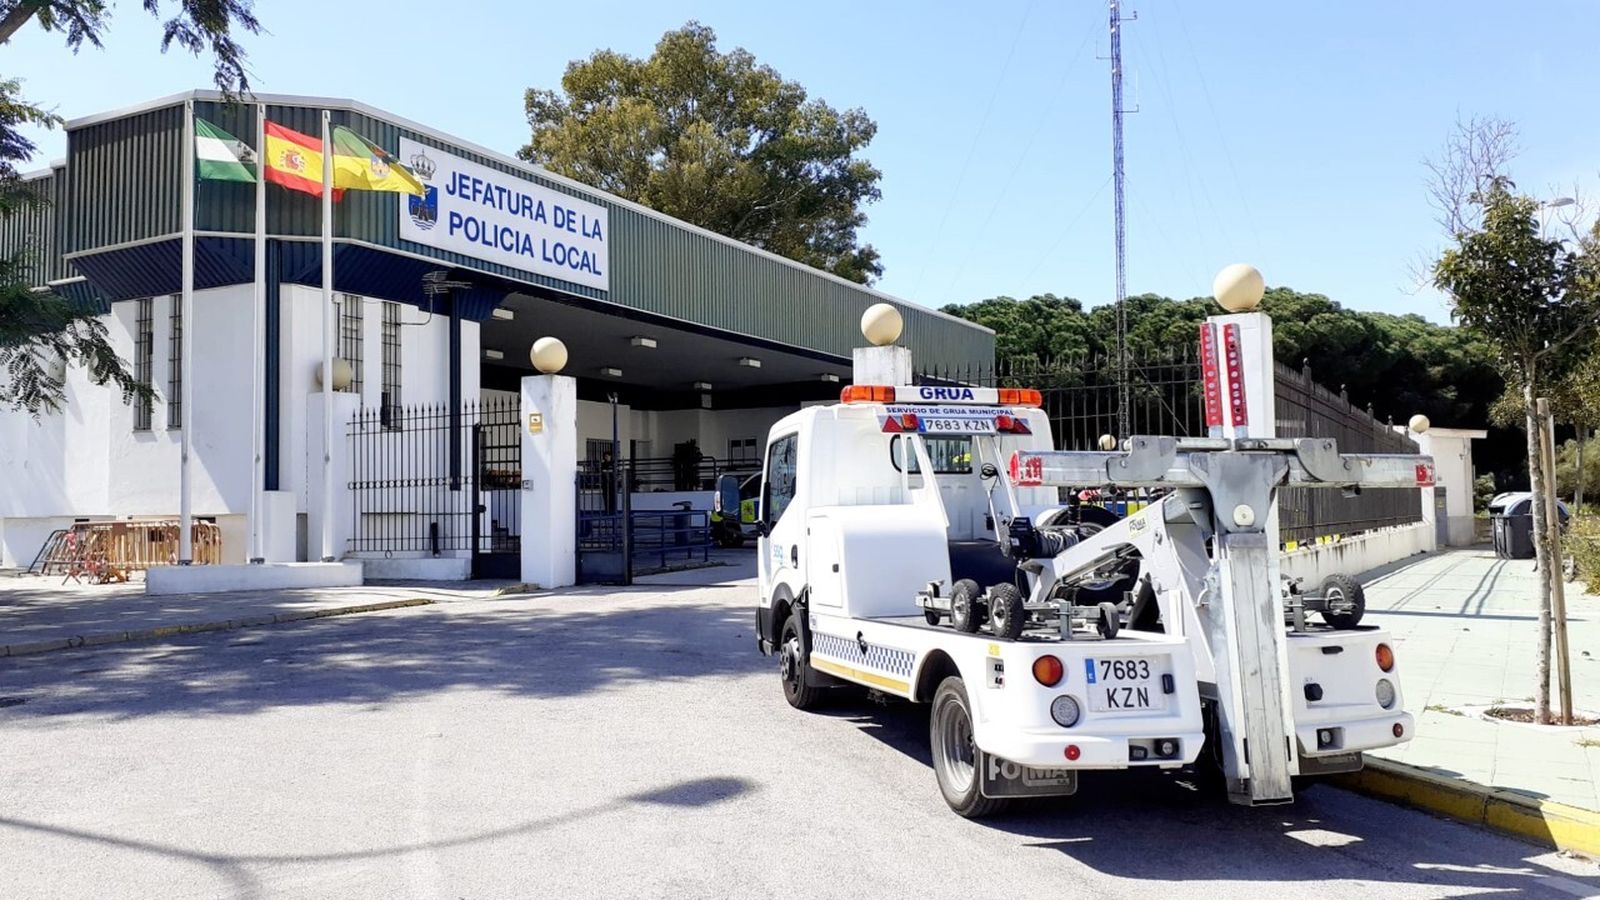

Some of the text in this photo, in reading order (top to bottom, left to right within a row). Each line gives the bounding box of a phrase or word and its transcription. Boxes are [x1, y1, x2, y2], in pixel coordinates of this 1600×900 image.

[446, 171, 603, 241] JEFATURA DE LA
[449, 211, 602, 275] POLICIA LOCAL
[920, 387, 974, 400] GRUA
[925, 419, 990, 431] 7683 KZN
[1100, 659, 1150, 681] 7683
[1106, 687, 1150, 708] KZN
